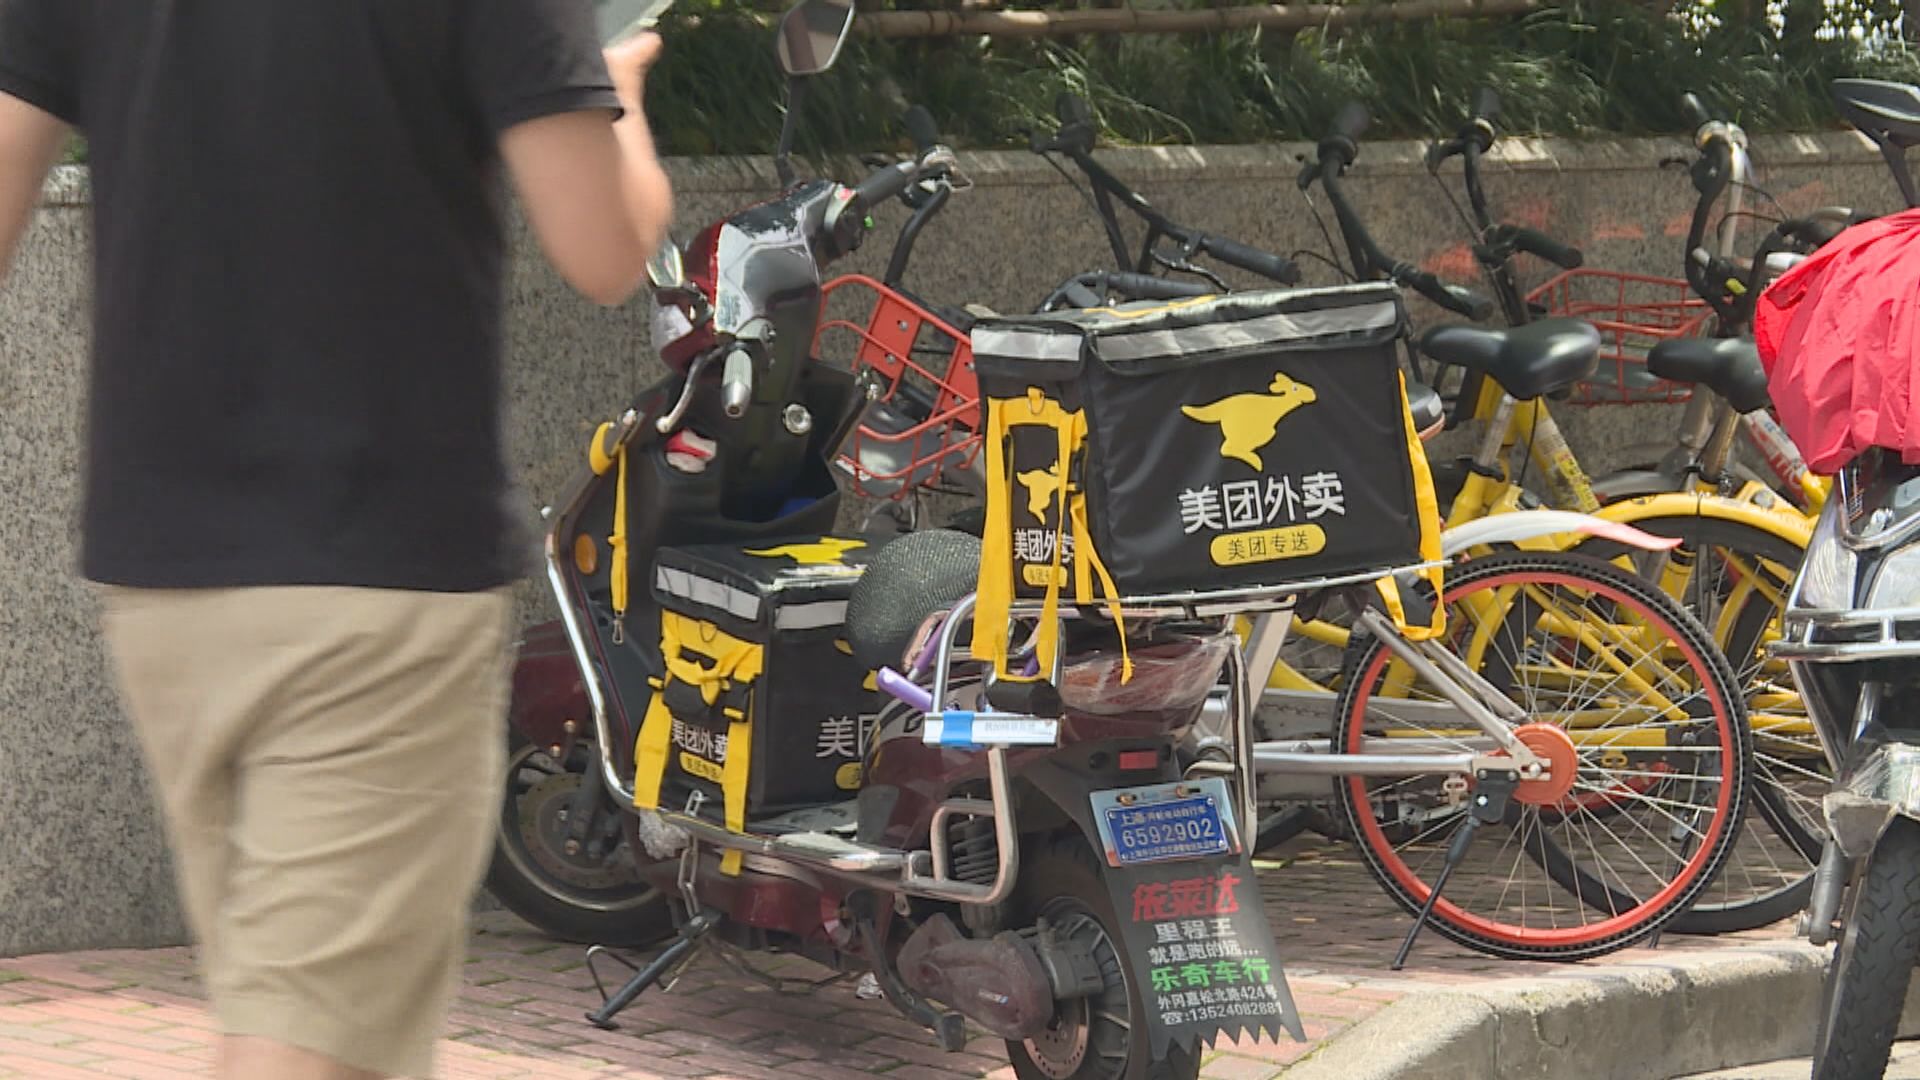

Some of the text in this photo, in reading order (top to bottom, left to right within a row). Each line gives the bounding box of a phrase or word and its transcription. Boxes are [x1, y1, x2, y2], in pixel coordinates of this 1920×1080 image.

[1177, 471, 1346, 535] 美团外卖
[1226, 531, 1311, 561] 美团专送
[1122, 817, 1216, 849] 6592902
[1132, 873, 1242, 923] 依莱达
[1154, 917, 1237, 944] 里程王
[1151, 957, 1271, 992] 乐奇车行
